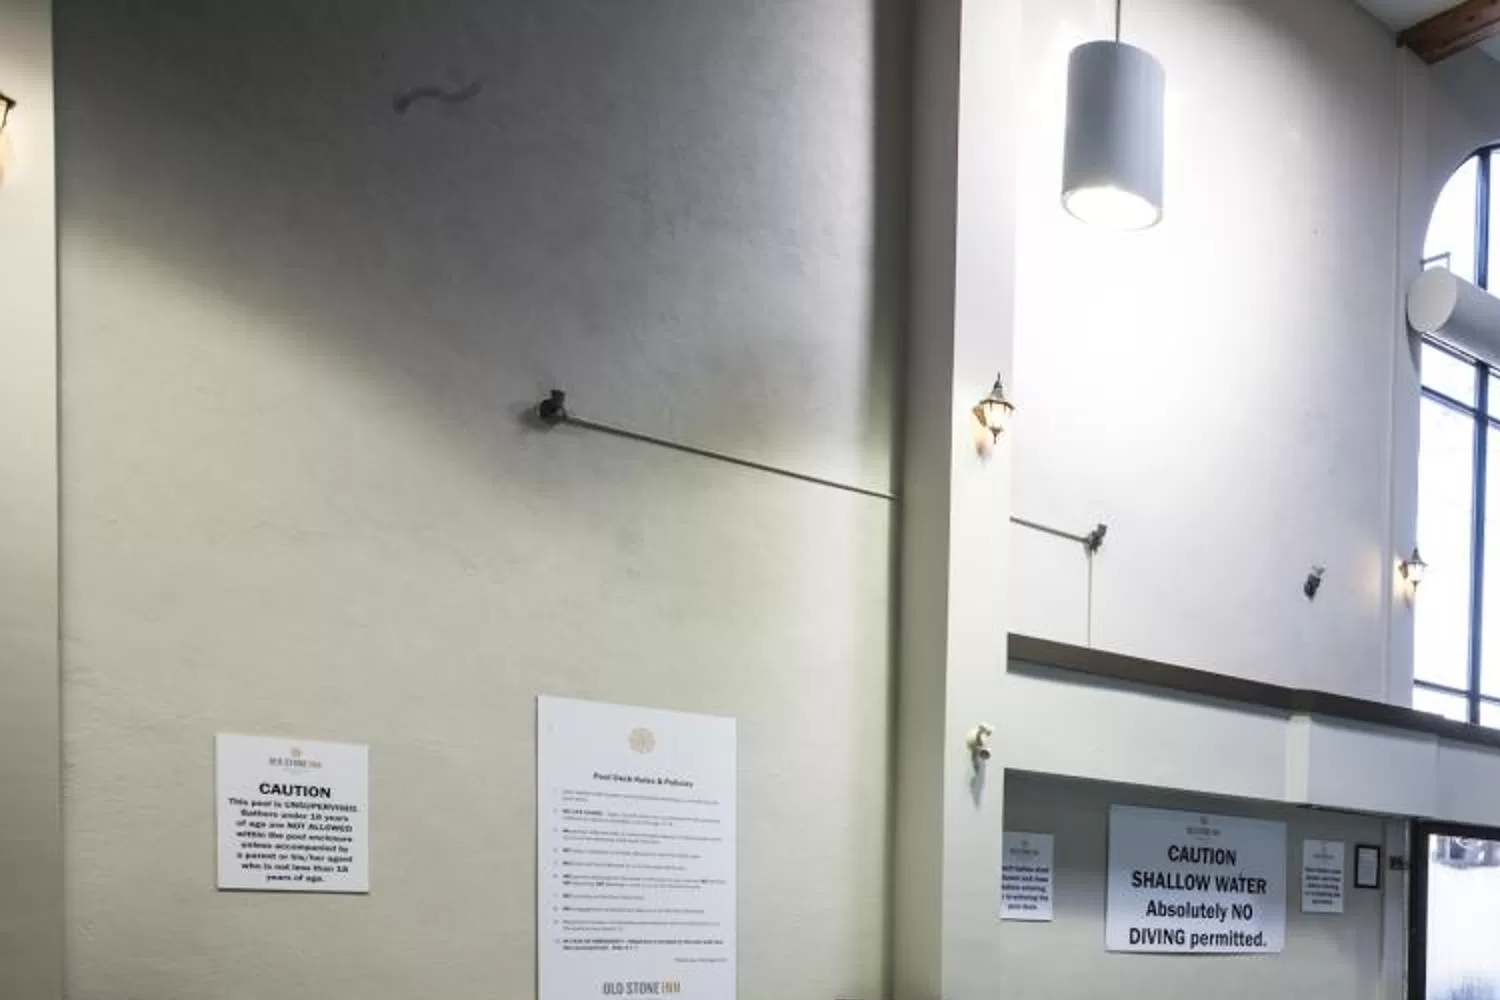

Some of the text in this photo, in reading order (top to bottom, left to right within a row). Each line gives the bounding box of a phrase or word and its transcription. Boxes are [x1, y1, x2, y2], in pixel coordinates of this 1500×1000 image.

[259, 783, 331, 798] CAUTION
[287, 822, 305, 830] NOT
[1167, 844, 1237, 866] CAUTION
[1131, 870, 1267, 894] SHALLOW WATER
[1146, 899, 1253, 922] Absolutely NO
[1129, 927, 1268, 949] DIVING permitted.
[626, 981, 660, 995] STONE
